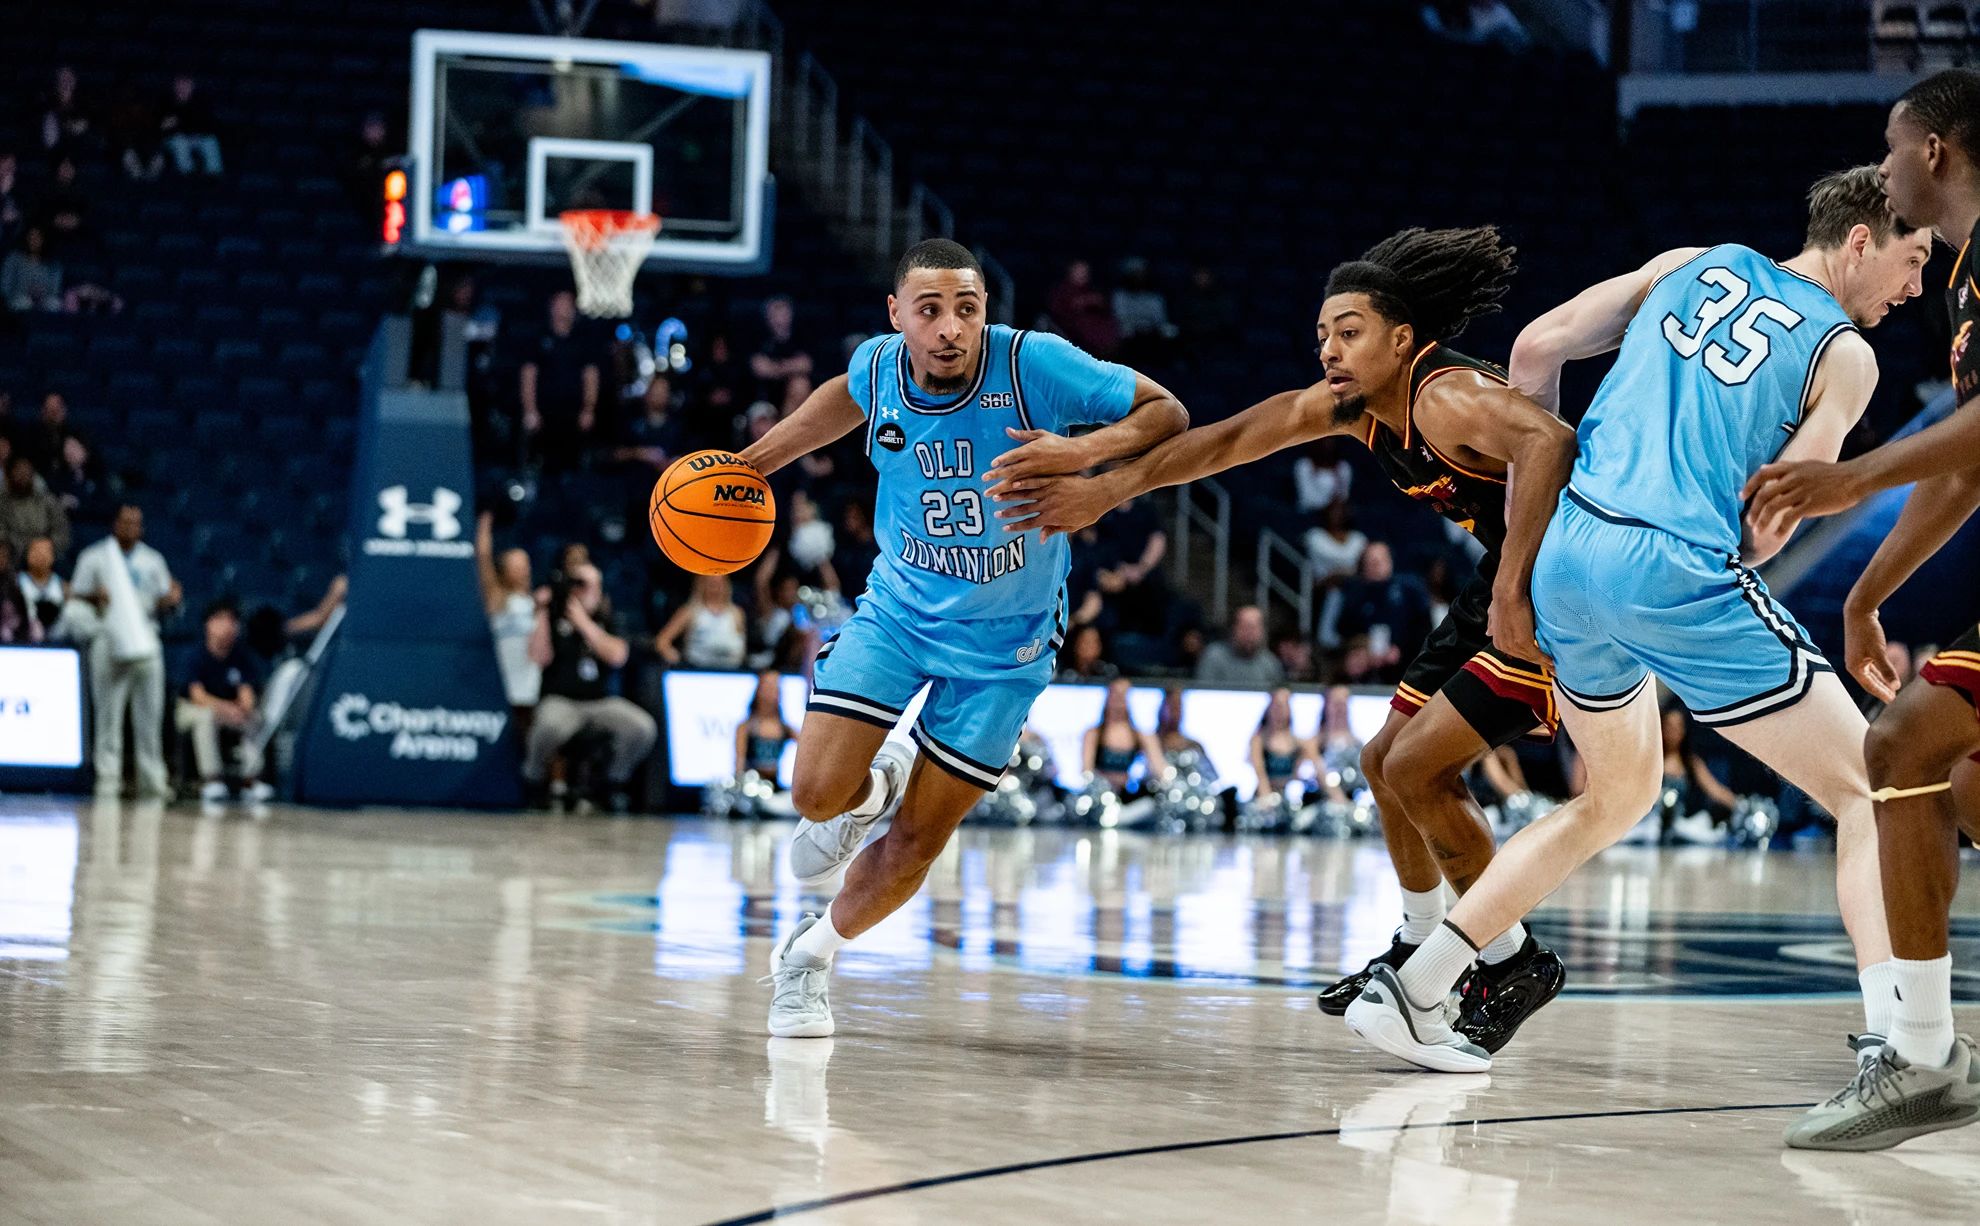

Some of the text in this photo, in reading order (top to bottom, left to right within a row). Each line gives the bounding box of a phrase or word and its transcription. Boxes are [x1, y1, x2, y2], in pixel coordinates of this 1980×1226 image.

[1661, 266, 1806, 387] 35
[980, 393, 1013, 409] SBC
[687, 453, 760, 473] Wilso
[914, 438, 974, 479] OLD
[714, 485, 765, 506] NCAA
[920, 488, 985, 537] 23
[901, 528, 1025, 584] DOMINION
[390, 731, 478, 761] Arena
